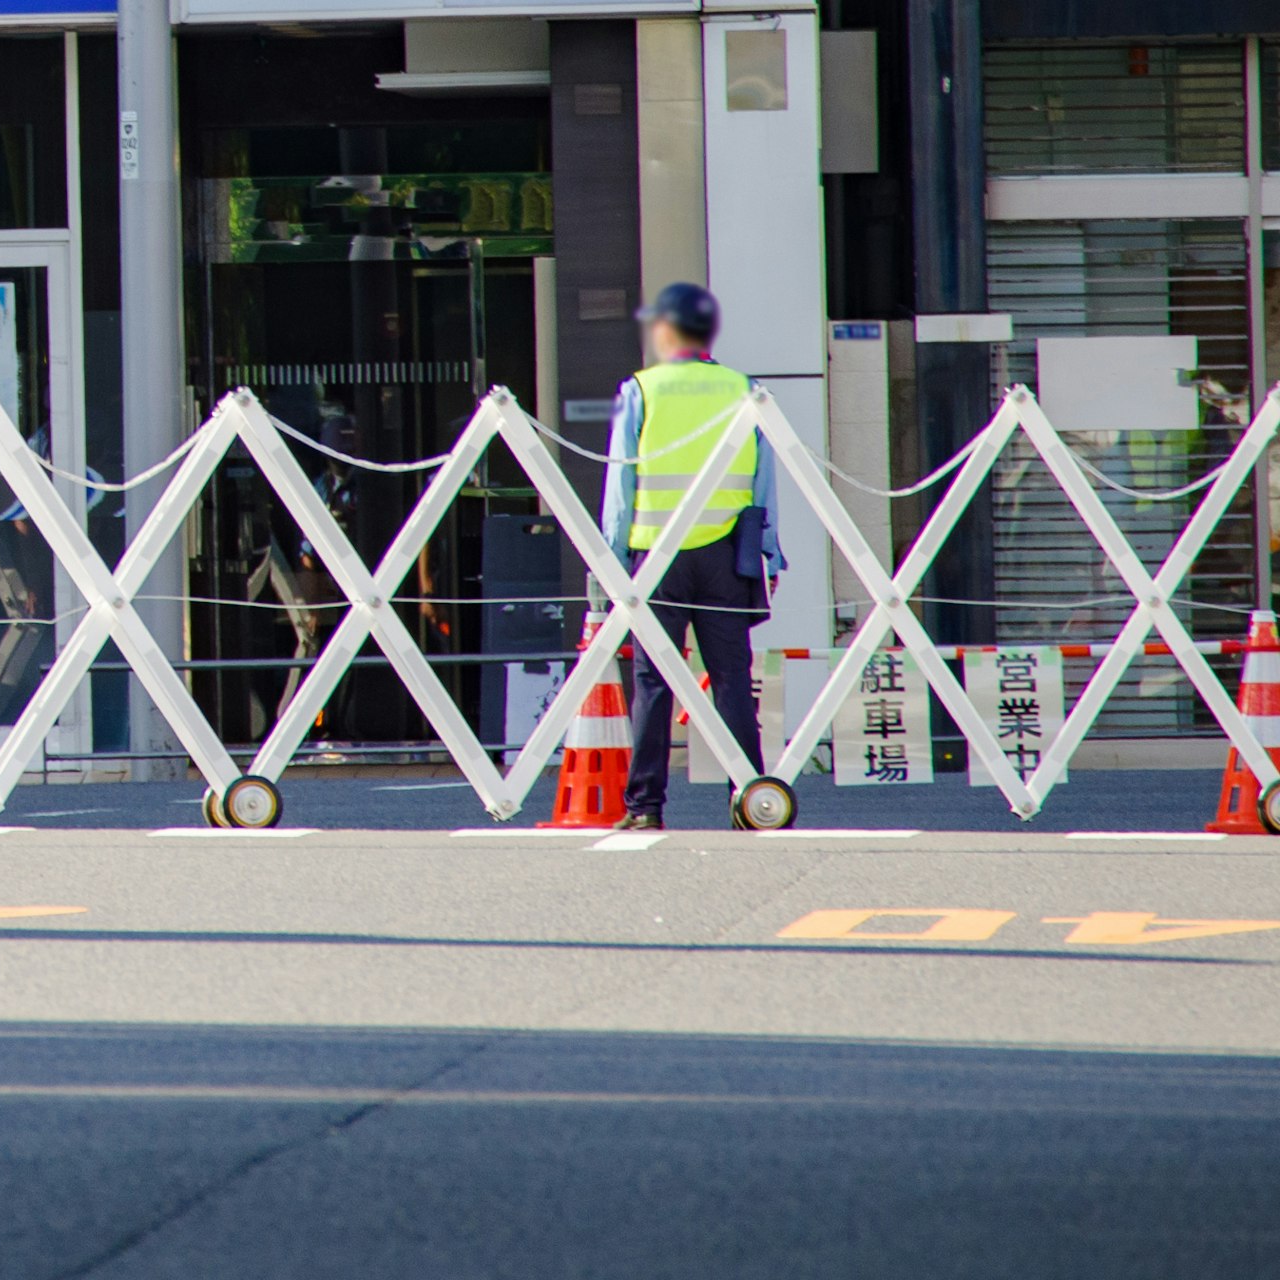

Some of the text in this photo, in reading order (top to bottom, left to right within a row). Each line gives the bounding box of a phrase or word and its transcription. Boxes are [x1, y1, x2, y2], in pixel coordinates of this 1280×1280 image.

[860, 653, 909, 782] 駐車場
[996, 653, 1043, 779] 営業中
